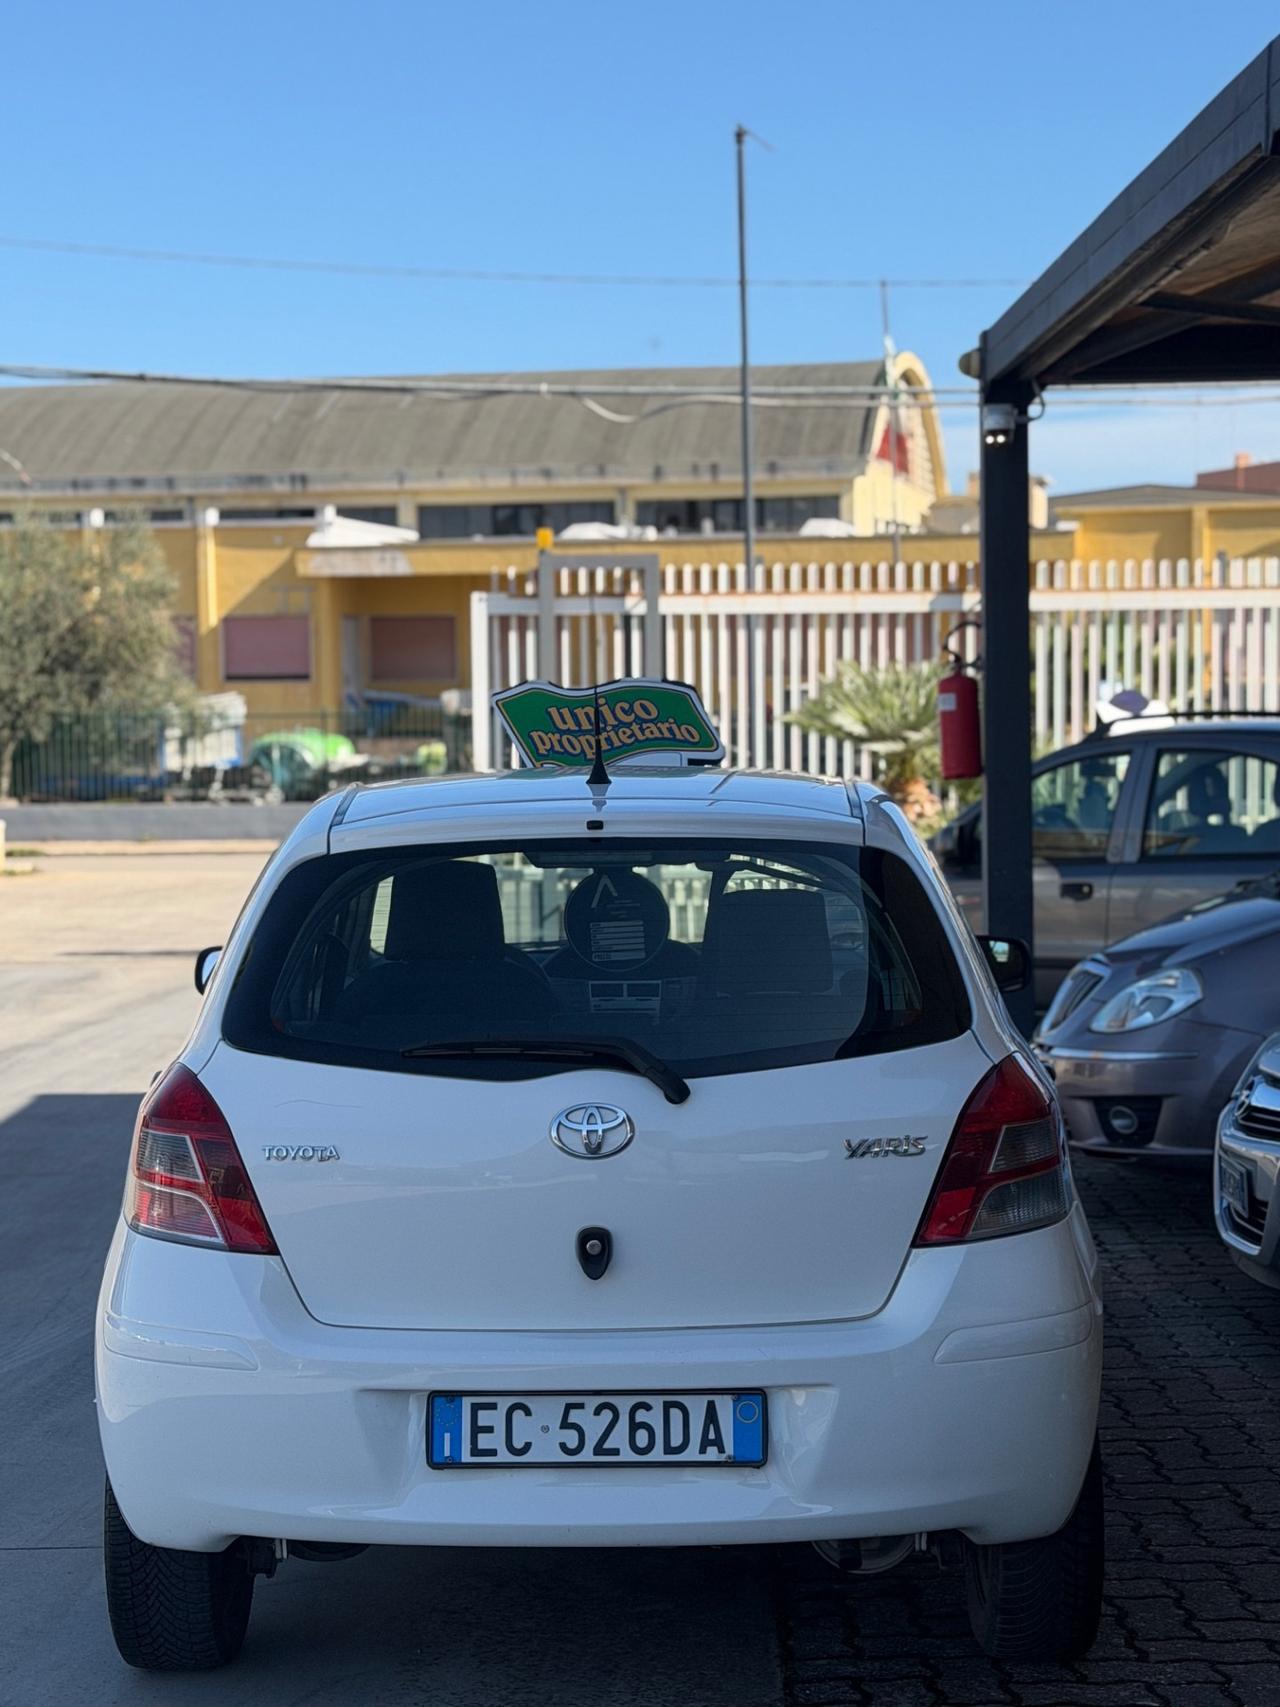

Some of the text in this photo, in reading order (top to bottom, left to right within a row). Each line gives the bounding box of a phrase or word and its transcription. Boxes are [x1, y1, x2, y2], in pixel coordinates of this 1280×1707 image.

[547, 697, 659, 731] unico
[529, 718, 700, 760] proprietario
[262, 1145, 340, 1161] TOYOTA
[469, 1399, 727, 1458] EC 526DA
